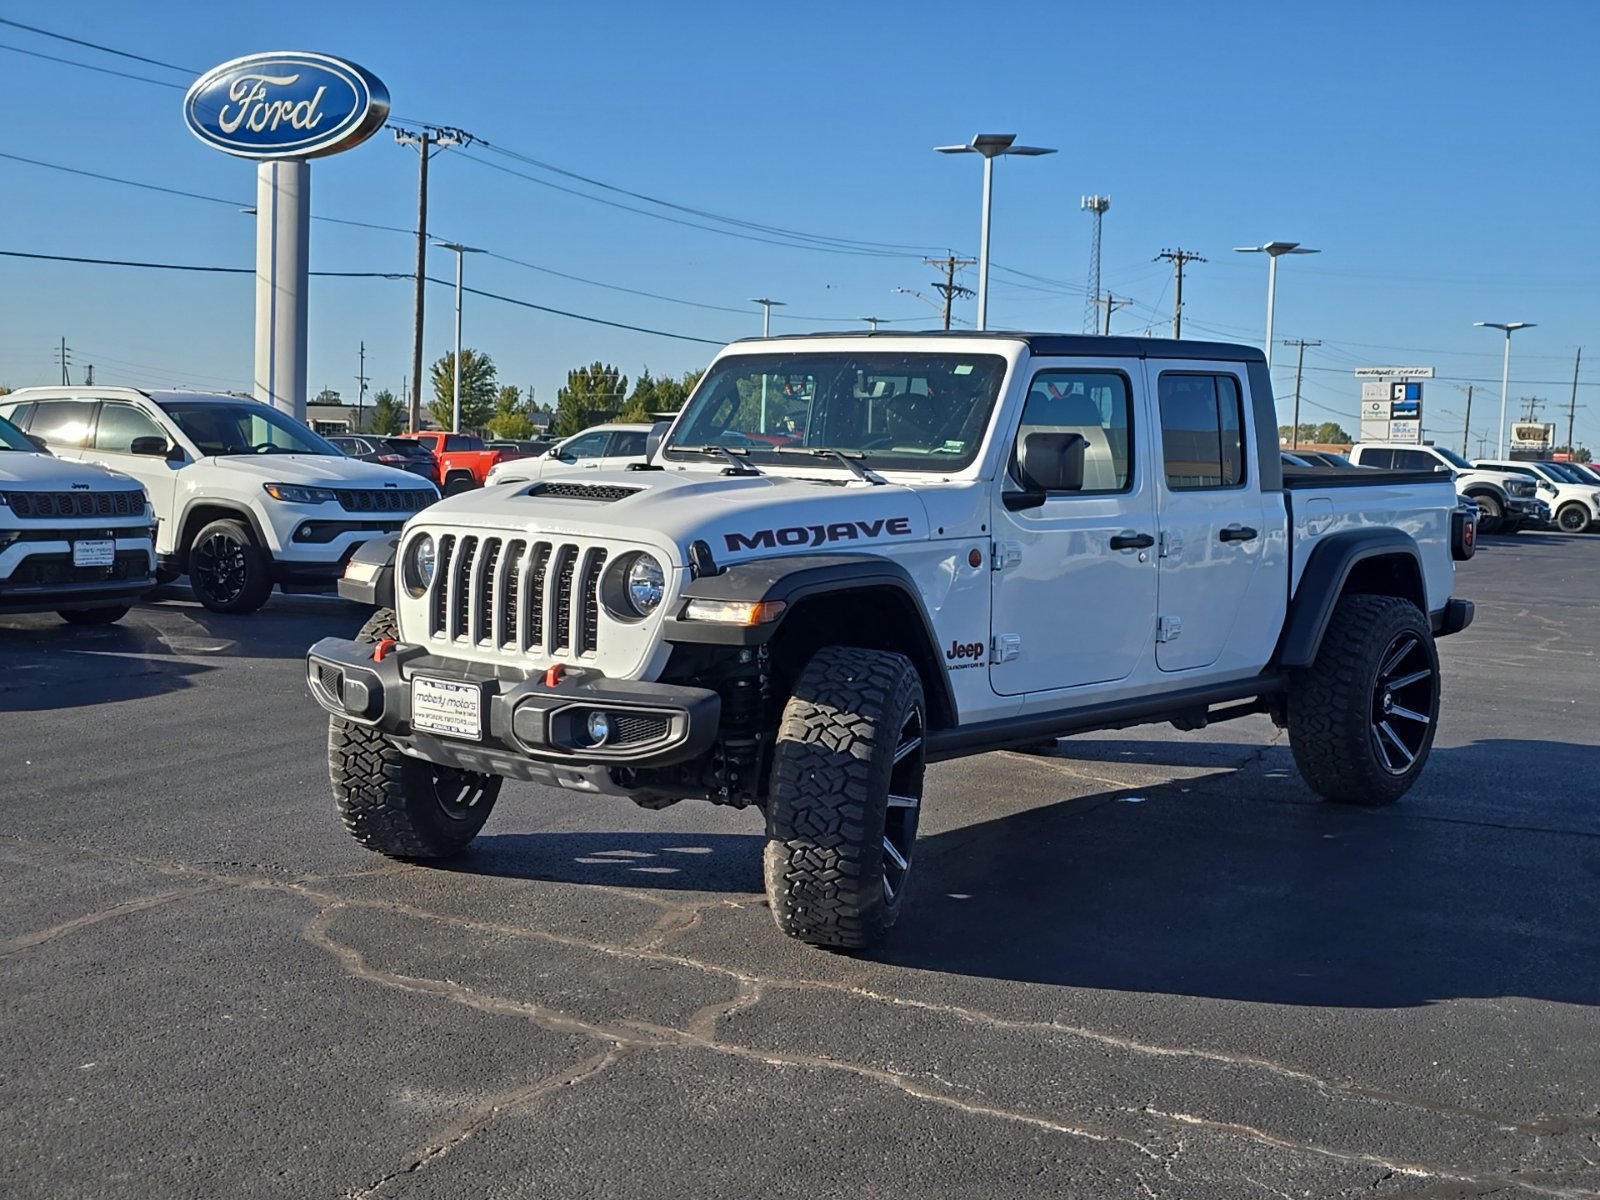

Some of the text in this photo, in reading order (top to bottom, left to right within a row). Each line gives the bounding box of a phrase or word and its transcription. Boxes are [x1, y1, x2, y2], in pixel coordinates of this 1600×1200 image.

[218, 74, 328, 134] Ford
[723, 517, 912, 552] MOJAVE
[946, 640, 985, 660] Jeep
[415, 692, 476, 710] moberly motors
